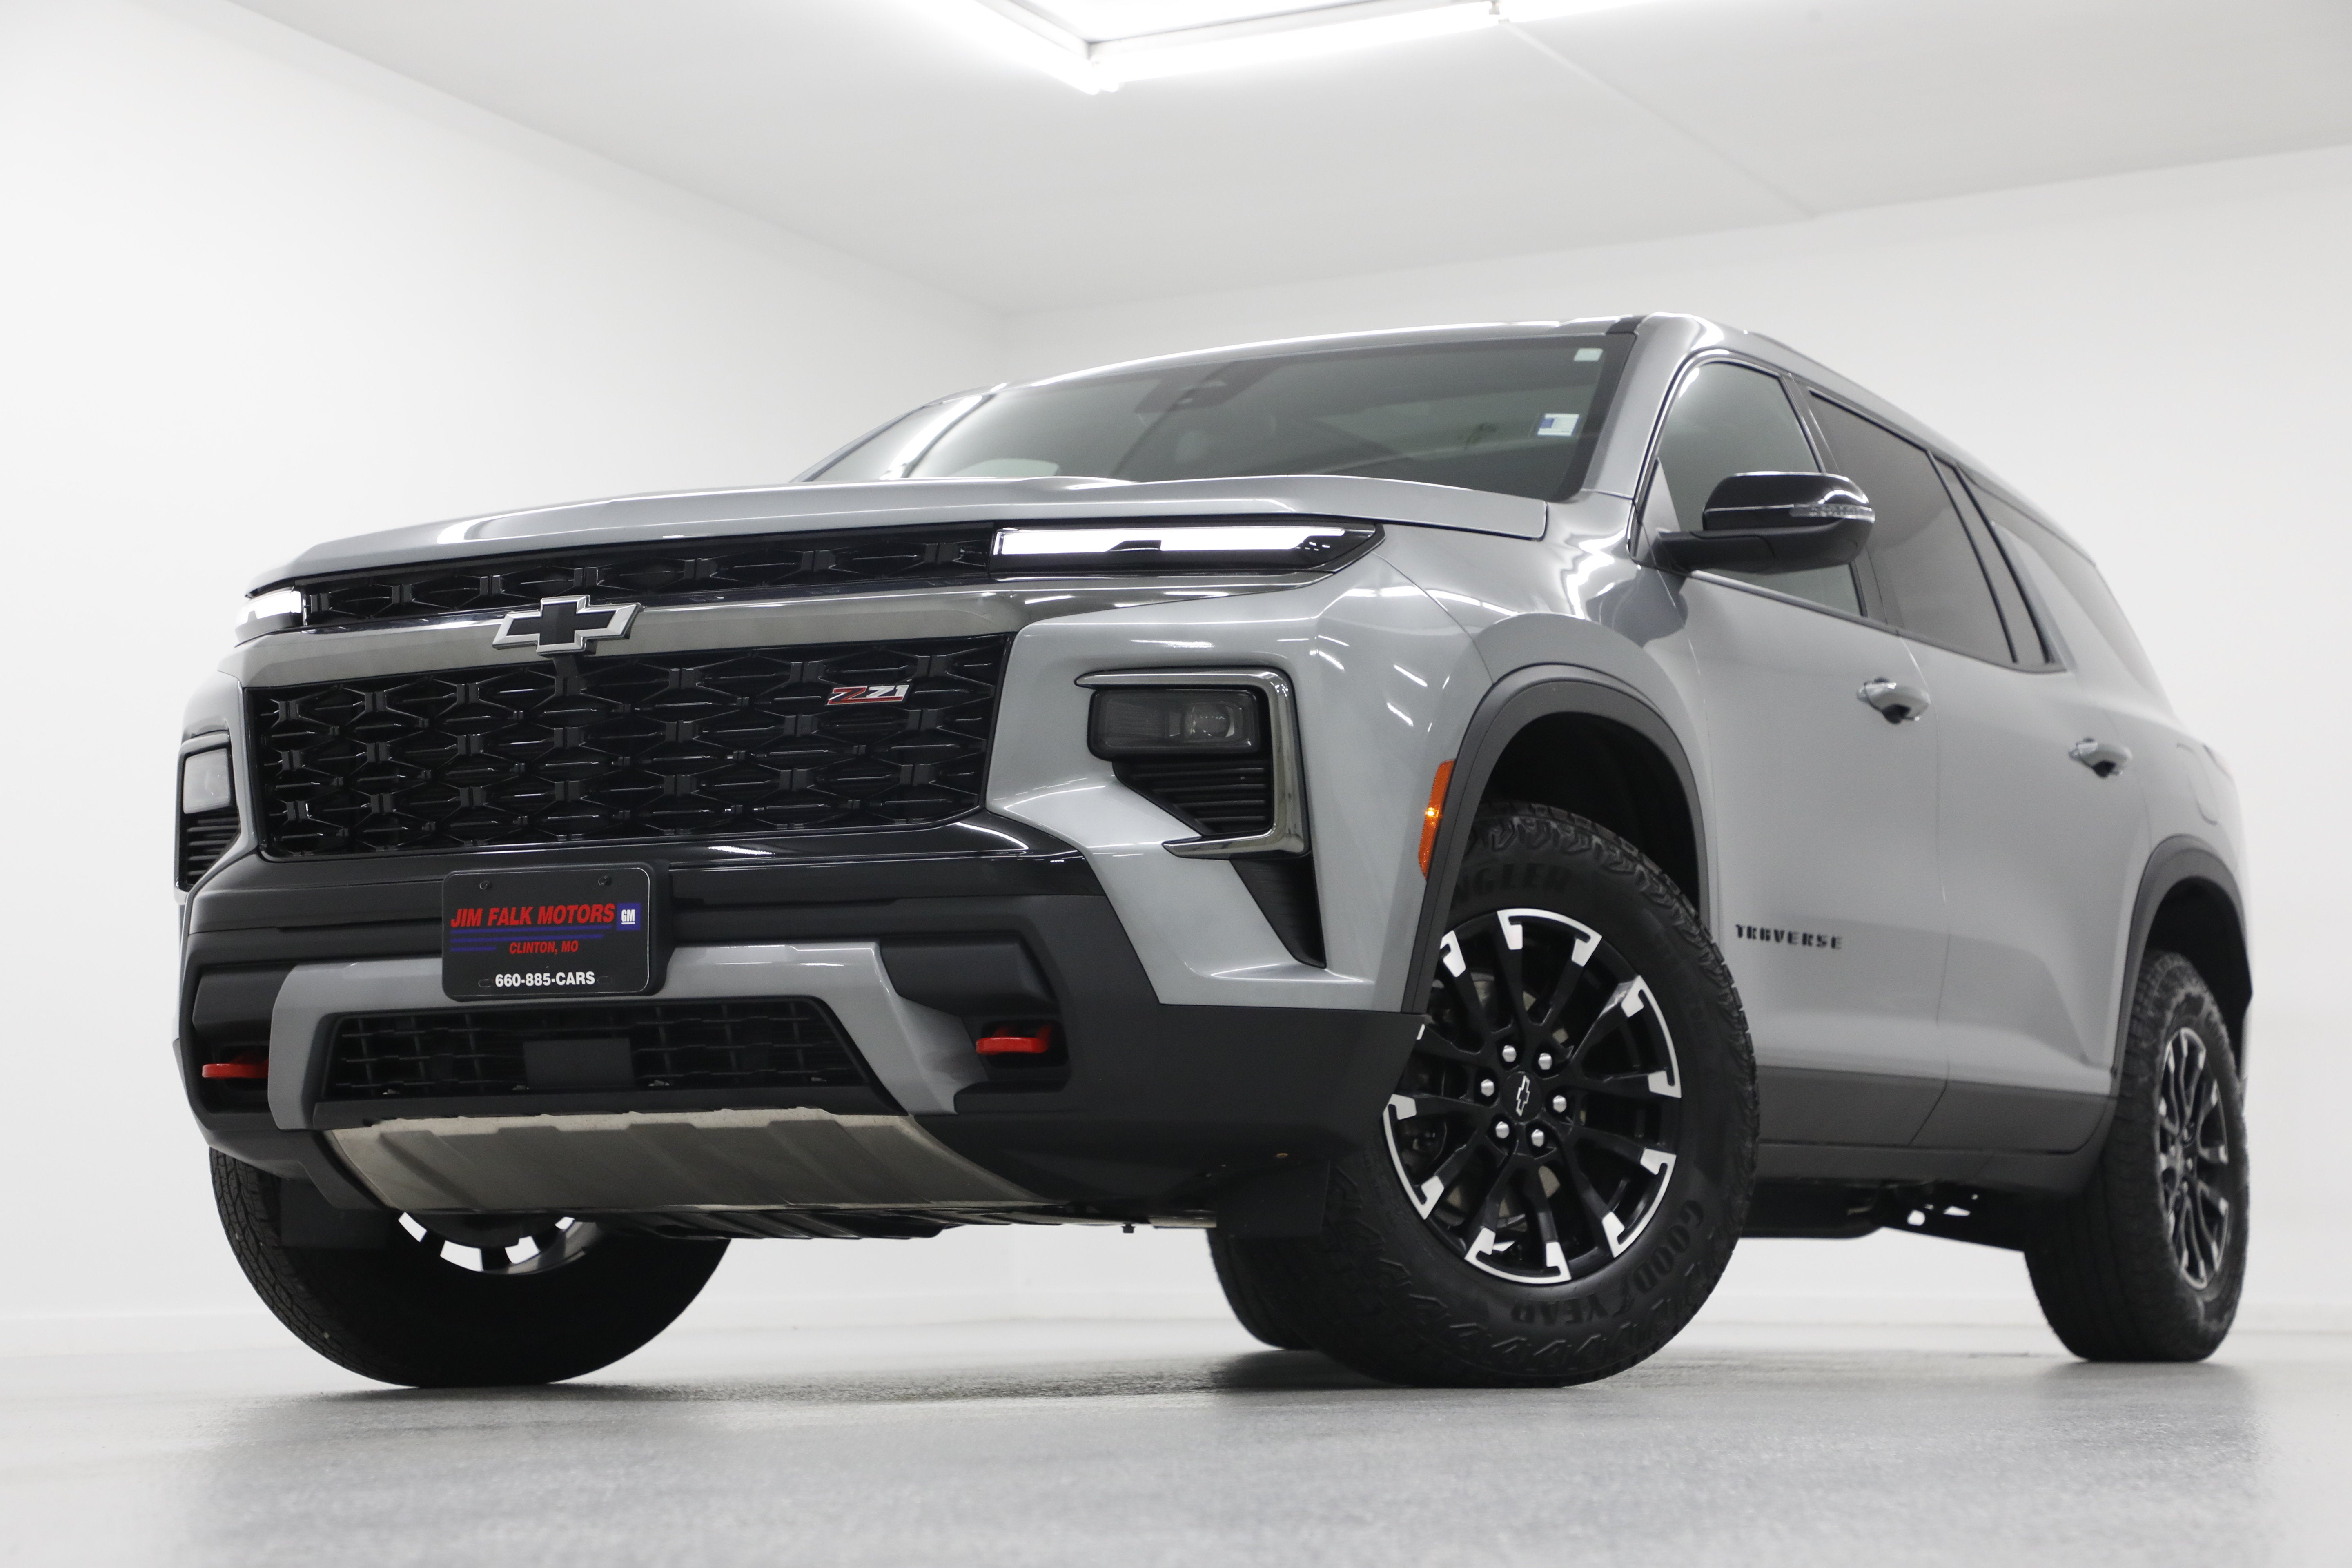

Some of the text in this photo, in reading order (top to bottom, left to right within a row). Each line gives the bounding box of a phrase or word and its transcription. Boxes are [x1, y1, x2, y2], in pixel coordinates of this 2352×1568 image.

[826, 684, 909, 705] Z71
[451, 903, 615, 928] JIM FALK MOTORS
[621, 909, 635, 923] GM
[1735, 924, 1843, 950] TRAVERSE
[509, 940, 579, 955] CLINTON, MO
[495, 971, 595, 987] 660-885-CARS
